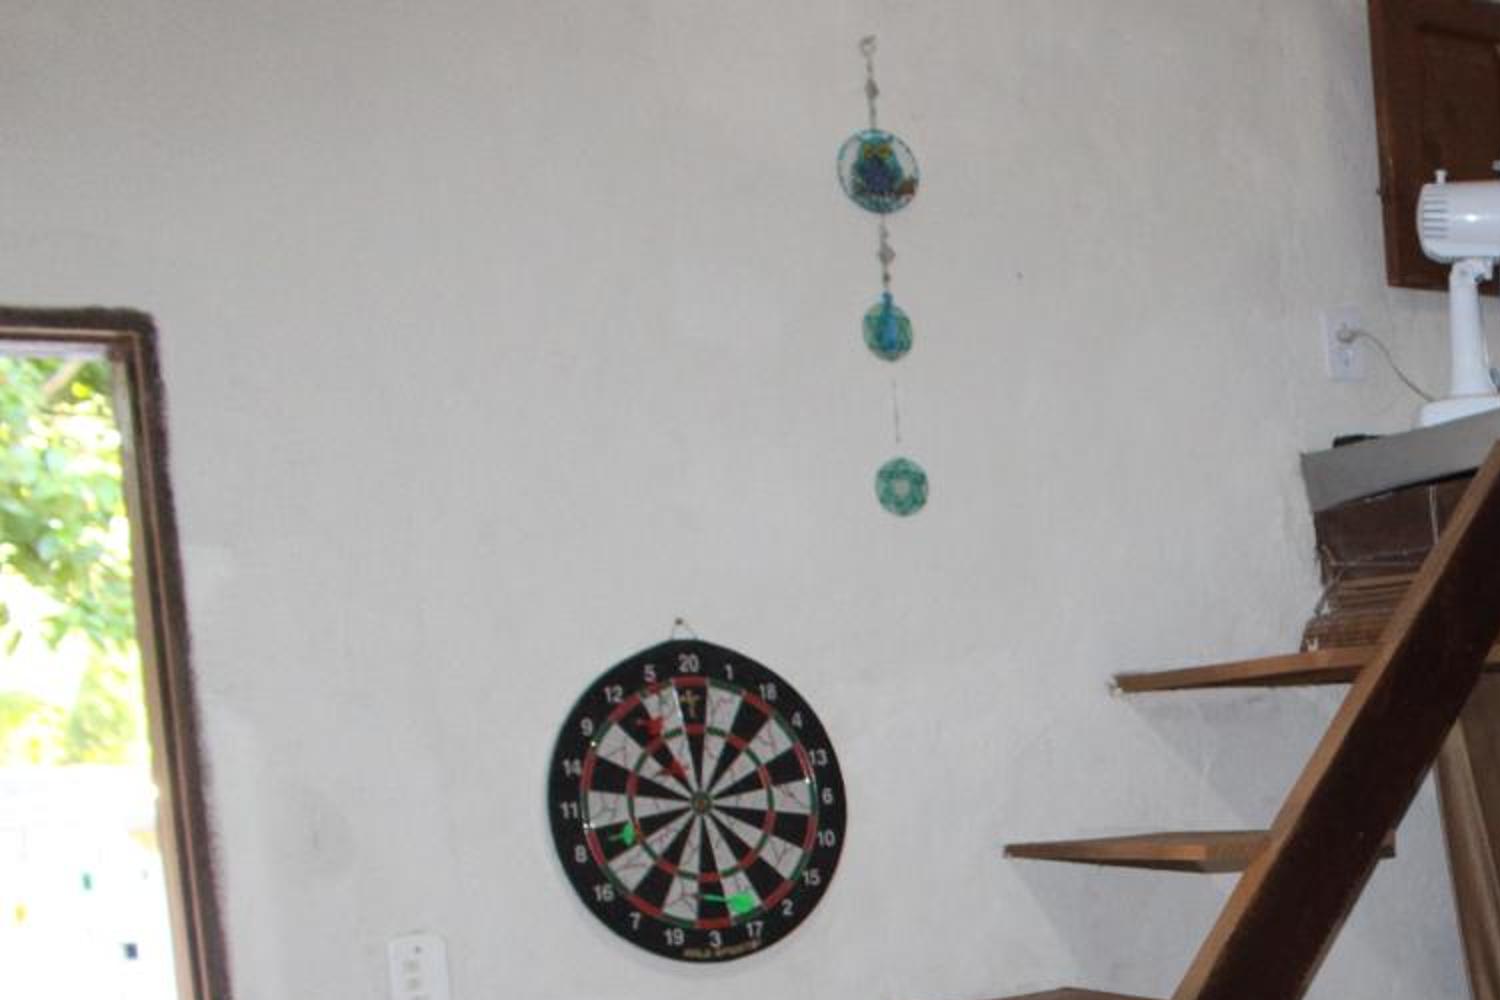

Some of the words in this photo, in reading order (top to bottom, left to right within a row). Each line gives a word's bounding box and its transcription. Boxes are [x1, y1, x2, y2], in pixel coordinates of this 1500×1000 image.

[679, 654, 700, 673] 20
[644, 666, 655, 681] 5
[726, 665, 733, 679] 1
[604, 687, 623, 702] 12
[759, 684, 776, 700] 18
[581, 718, 593, 735] 9
[793, 713, 803, 727] 4
[810, 750, 828, 766] 13
[563, 759, 581, 775] 14
[822, 789, 833, 803] 6
[562, 804, 578, 819] 11
[818, 831, 836, 847] 10
[804, 870, 821, 886] 15
[595, 885, 613, 900] 16
[782, 901, 794, 917] 2
[630, 914, 641, 931] 7
[746, 923, 764, 938] 17
[664, 928, 684, 946] 19
[709, 932, 721, 948] 3
